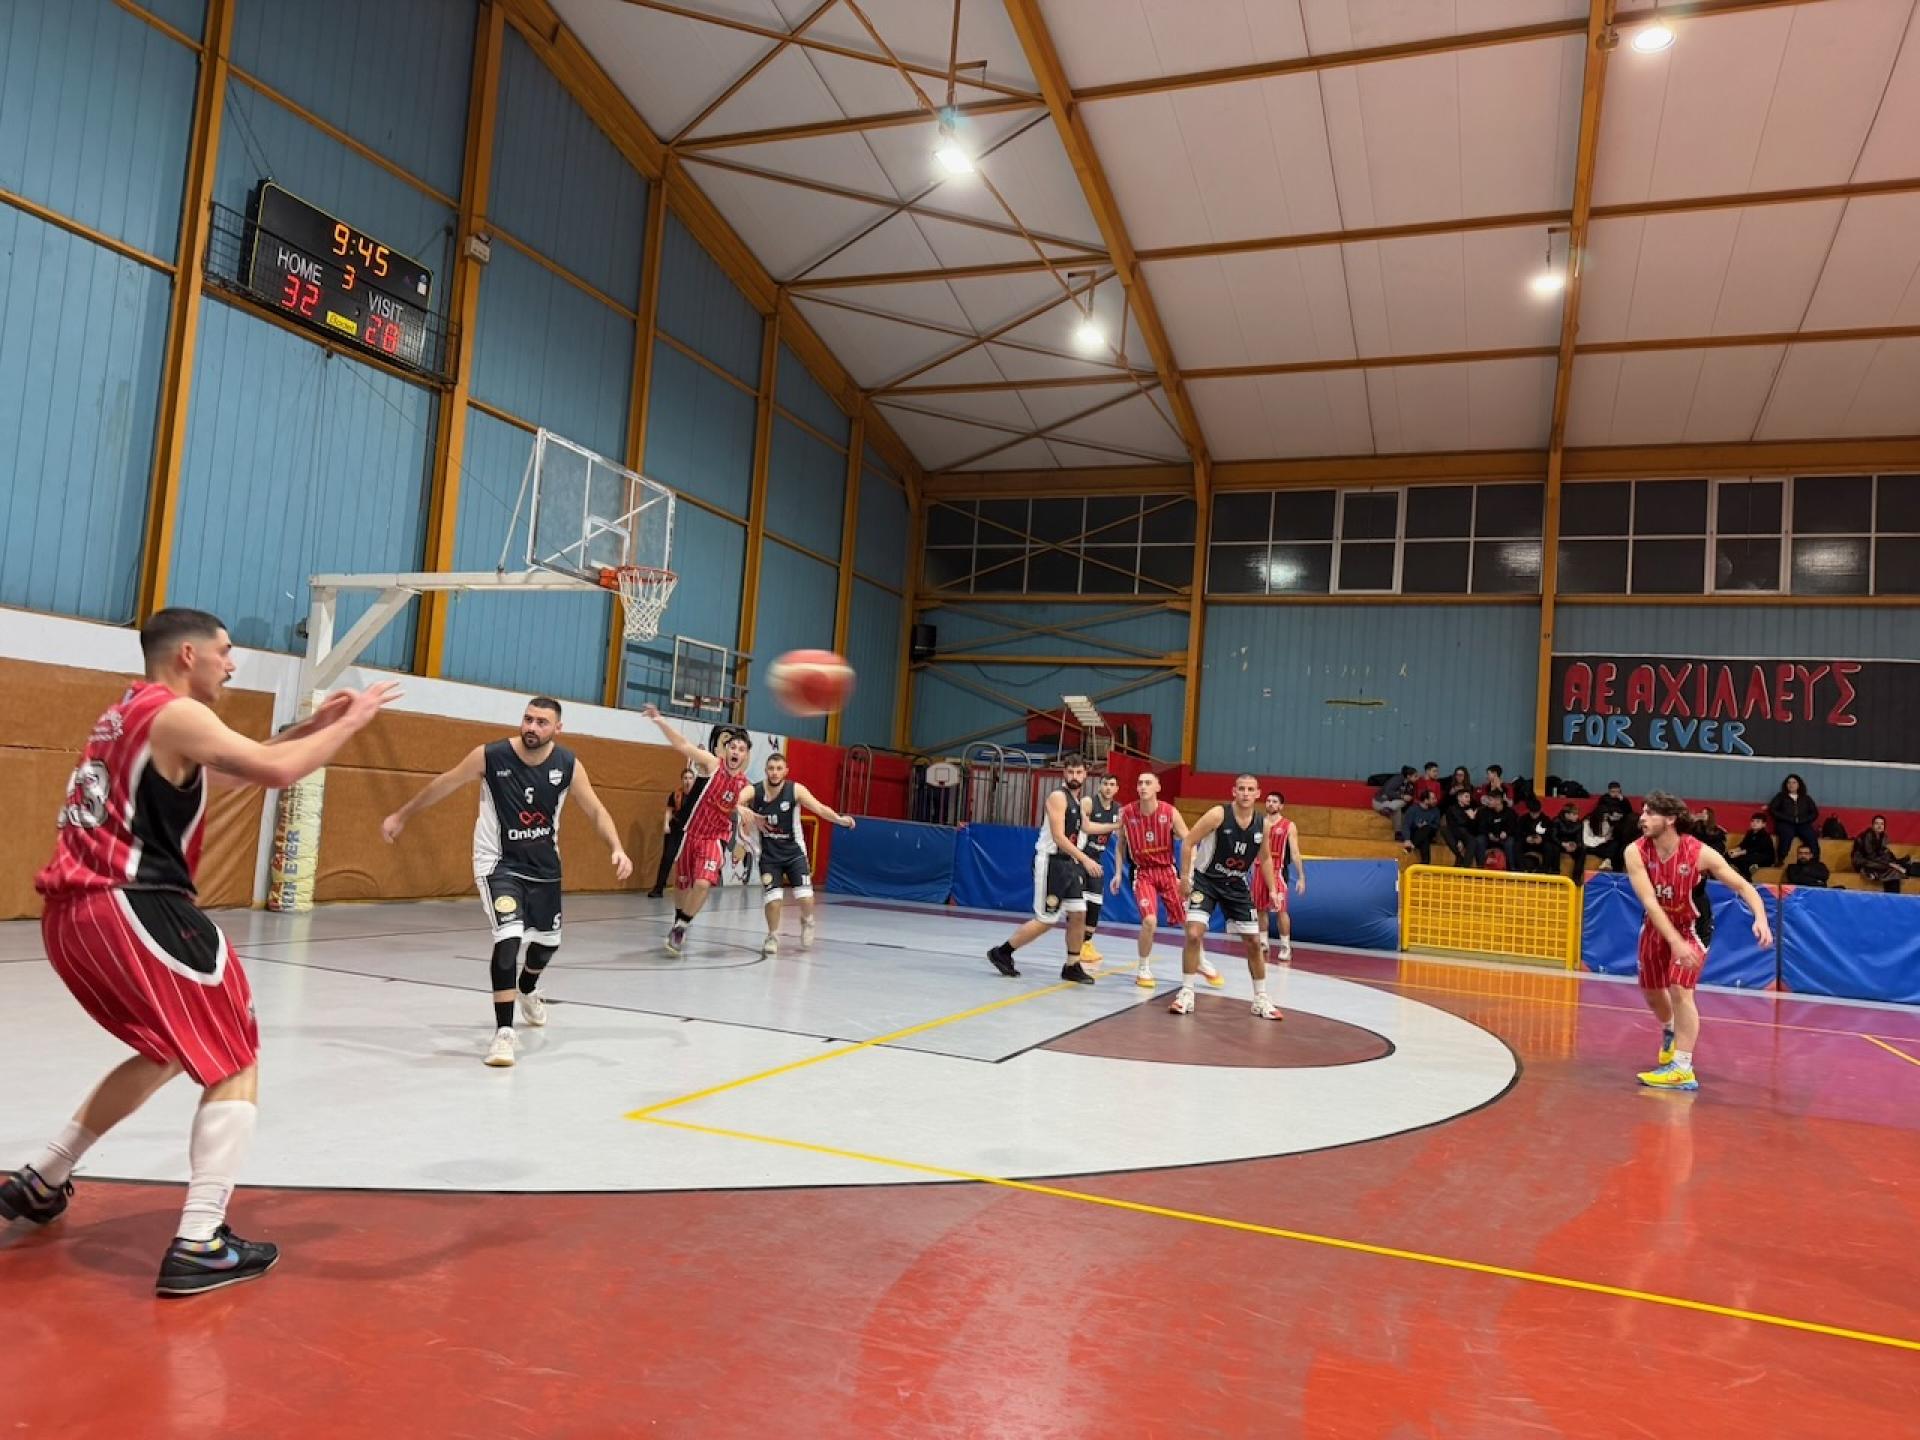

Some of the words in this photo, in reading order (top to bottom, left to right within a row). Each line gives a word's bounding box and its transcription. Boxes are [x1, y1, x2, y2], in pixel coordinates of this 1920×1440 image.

[332, 223, 390, 277] 9:45
[277, 247, 324, 286] HOME
[341, 265, 356, 290] 3
[281, 274, 320, 316] 32
[367, 291, 404, 323] VISIT
[1562, 714, 1635, 747] FOR
[1649, 718, 1754, 757] EVER
[524, 786, 535, 805] 5
[1145, 831, 1155, 842] 9
[1234, 841, 1248, 855] 14
[1655, 884, 1673, 899] 14
